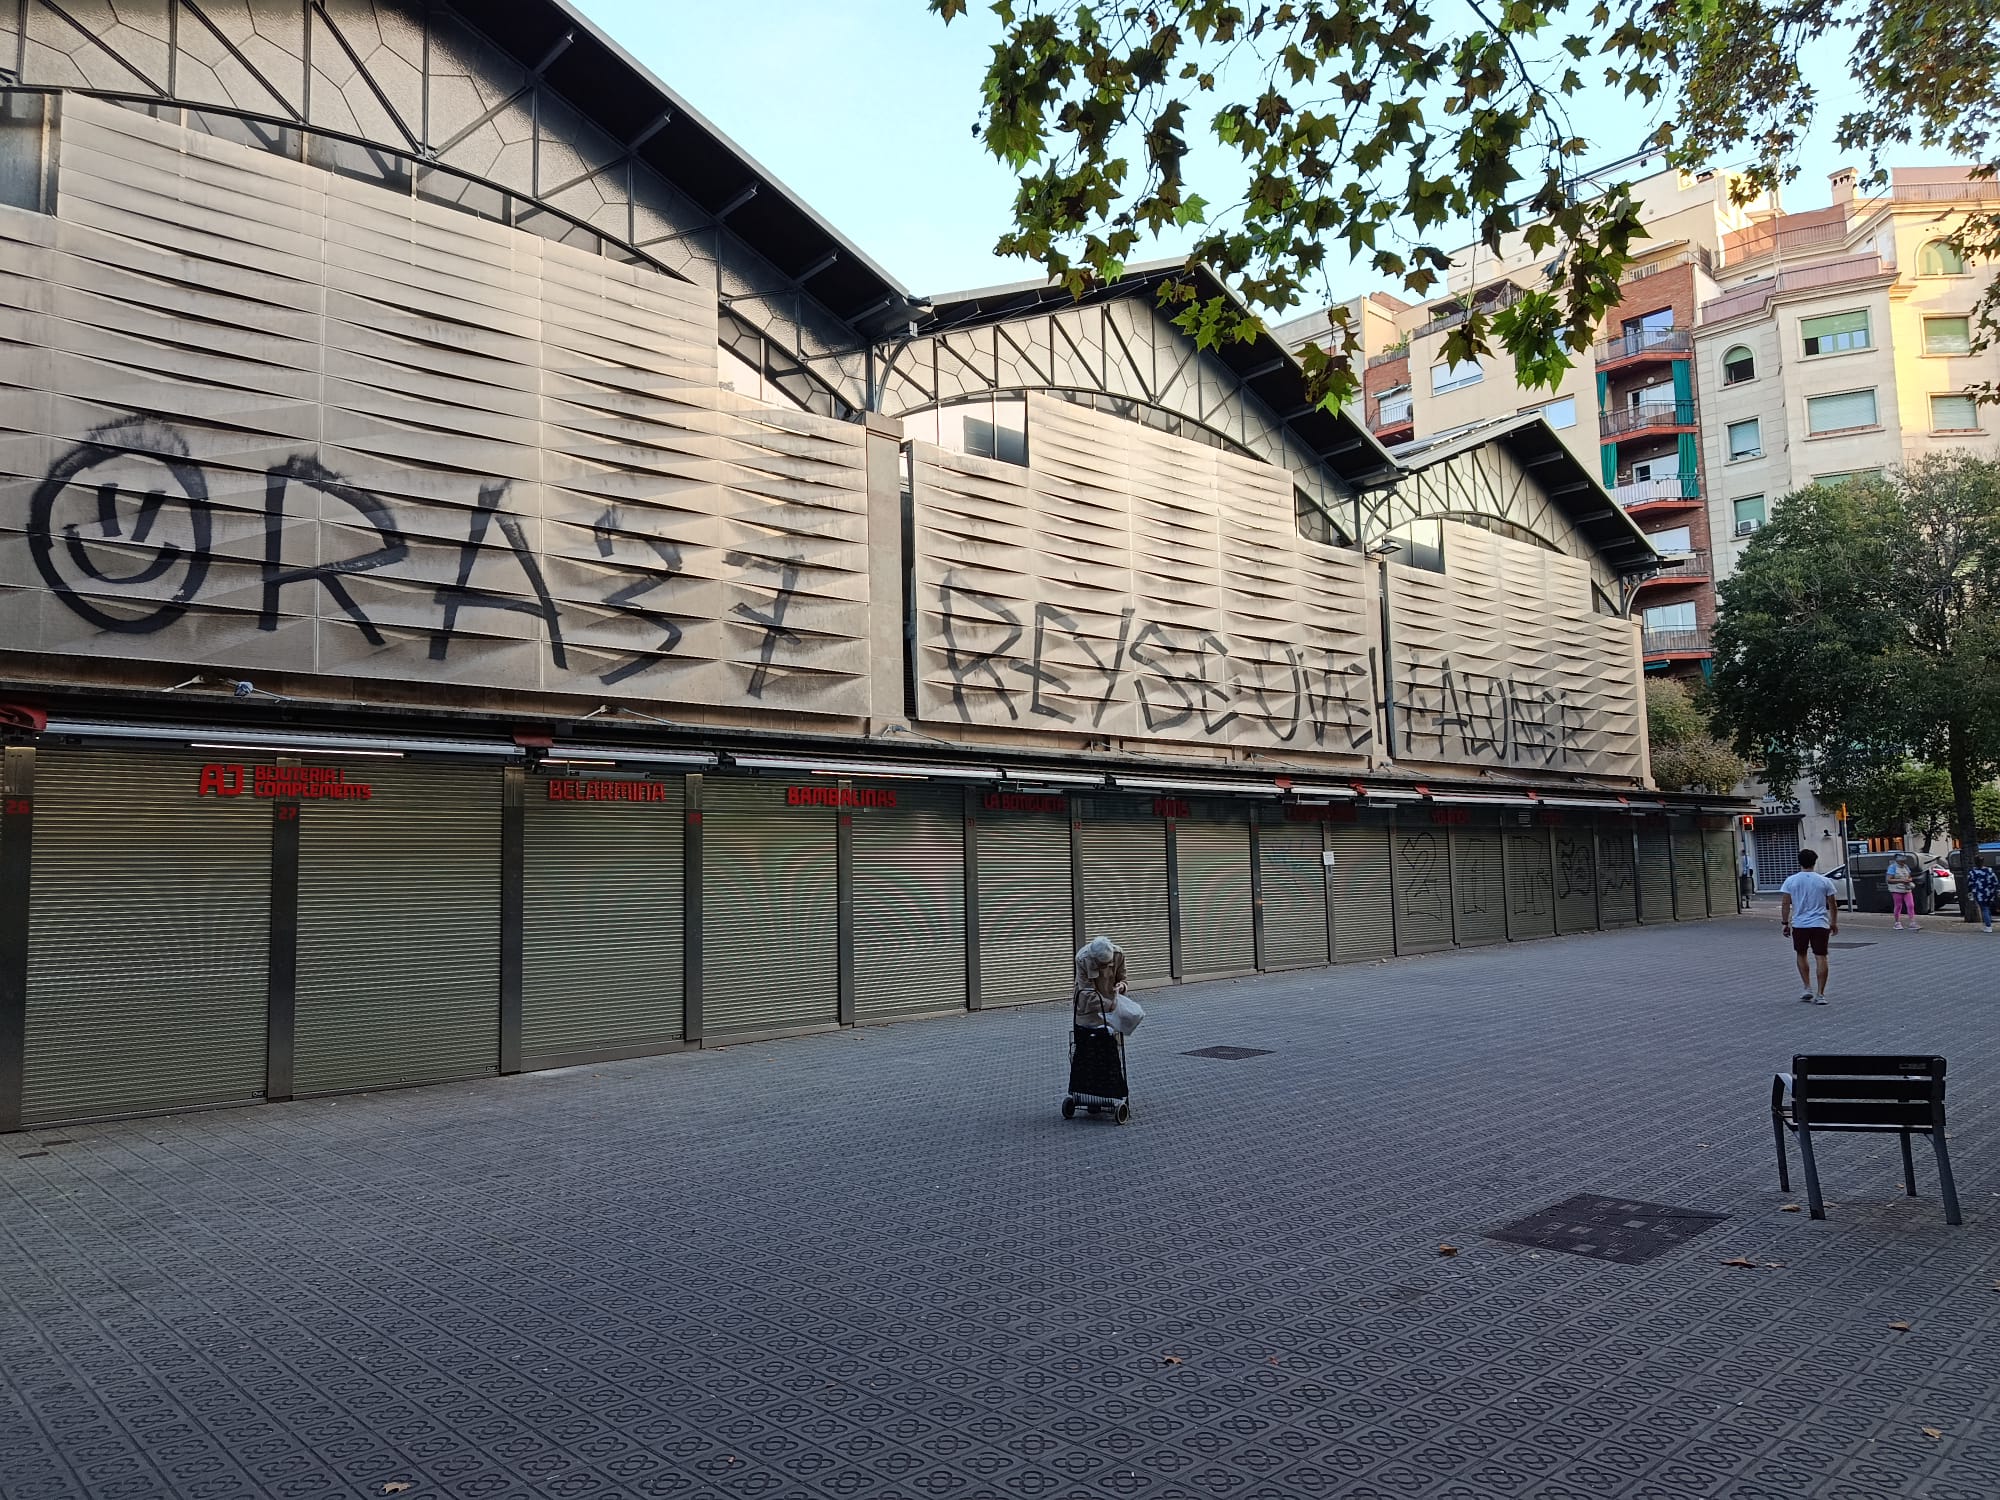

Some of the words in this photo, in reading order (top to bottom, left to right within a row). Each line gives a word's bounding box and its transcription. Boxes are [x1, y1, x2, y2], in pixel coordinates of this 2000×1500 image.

[198, 763, 245, 796] AJ
[254, 781, 373, 800] COMPLEMENTS
[548, 780, 667, 802] BELARMINA
[787, 785, 897, 808] BAMBALINAS
[278, 805, 298, 821] 27
